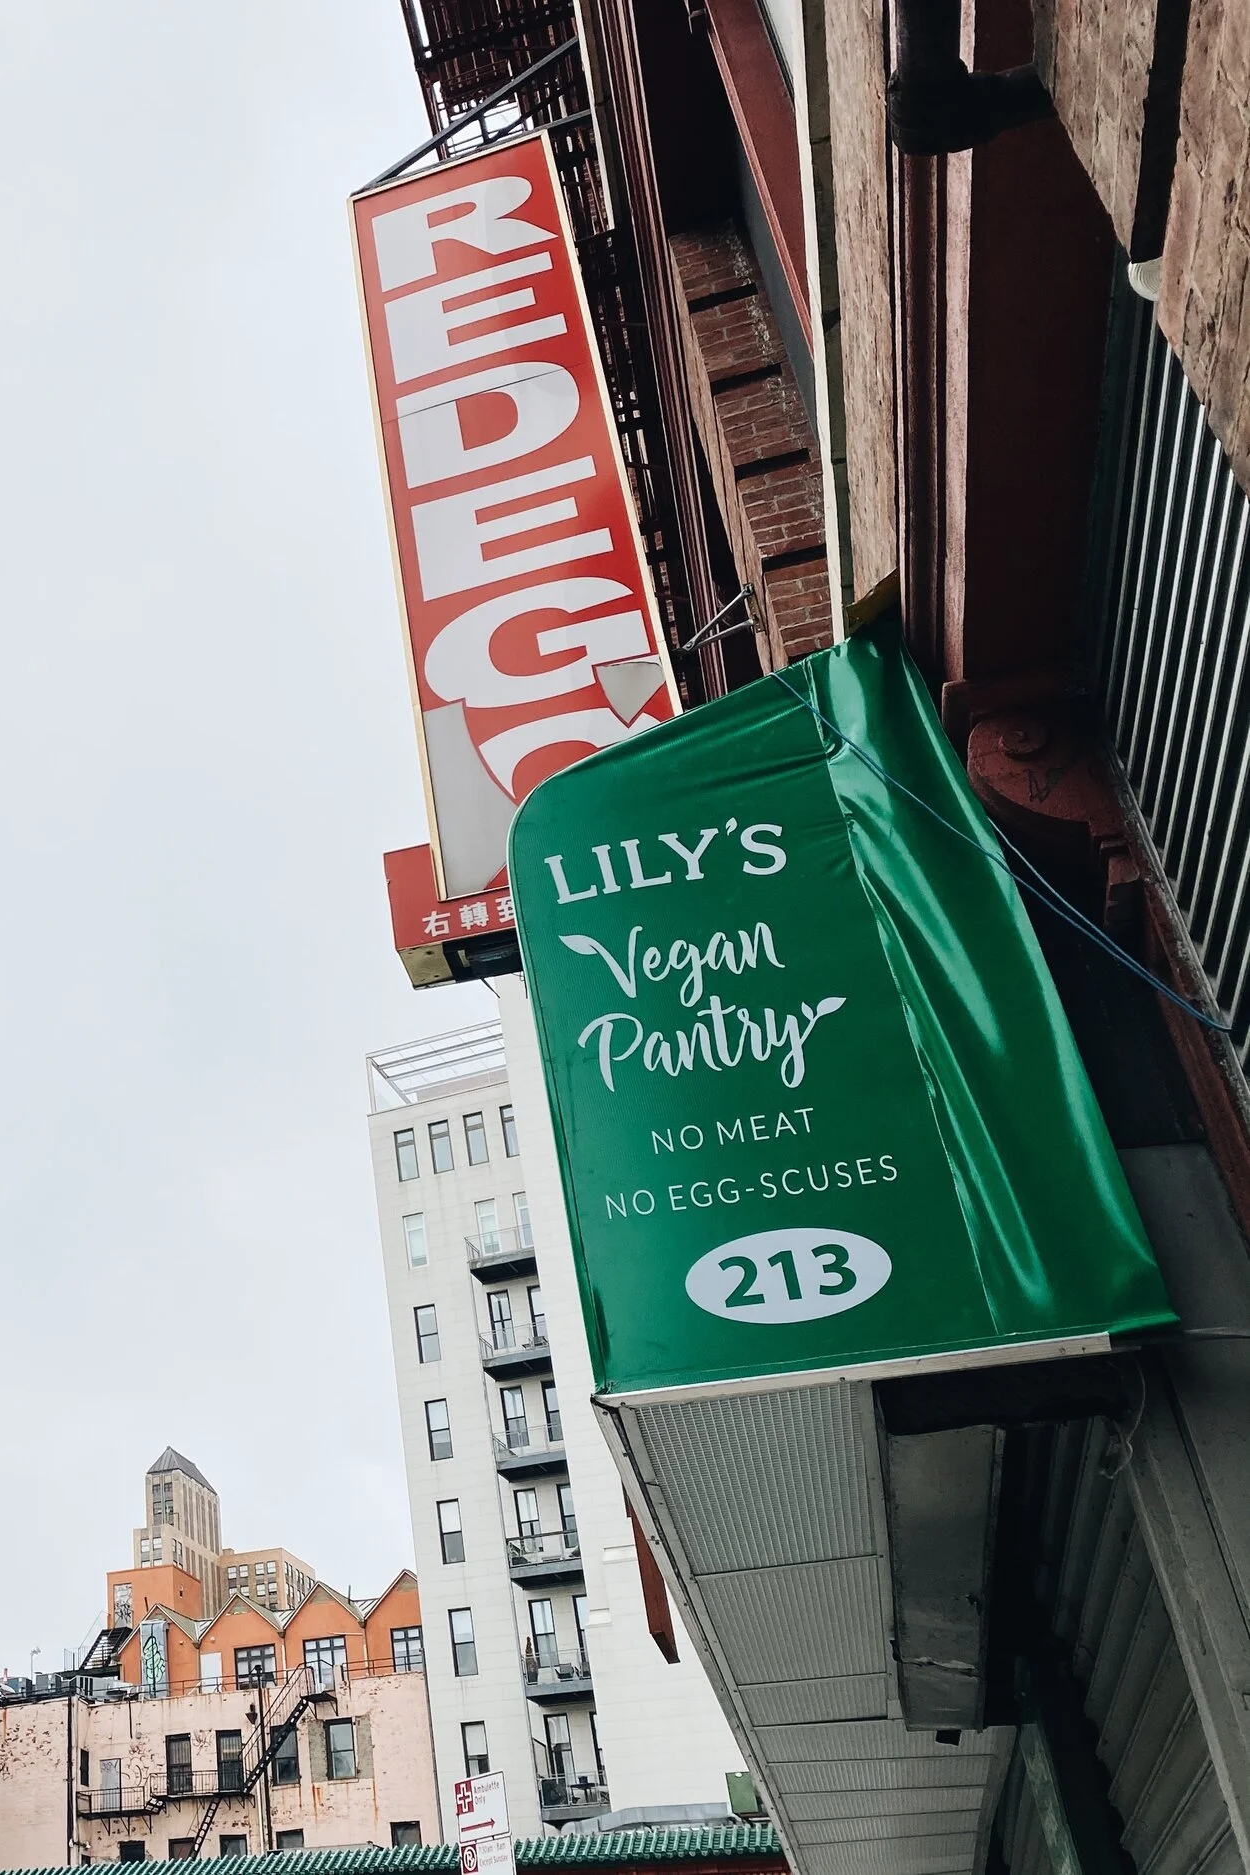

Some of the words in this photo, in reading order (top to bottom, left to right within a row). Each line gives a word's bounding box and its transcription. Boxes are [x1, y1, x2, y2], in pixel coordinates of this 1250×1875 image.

[544, 817, 788, 904] LILY'S
[559, 922, 785, 1007] Vegan
[578, 995, 846, 1092] Pantry
[652, 1125, 704, 1155] NO
[717, 1107, 814, 1146] MEAT
[606, 1190, 655, 1220] NO
[670, 1154, 898, 1213] EGG-SCUSES
[717, 1242, 858, 1308] 213
[473, 1781, 500, 1795] Ambulette
[474, 1796, 486, 1806] Only
